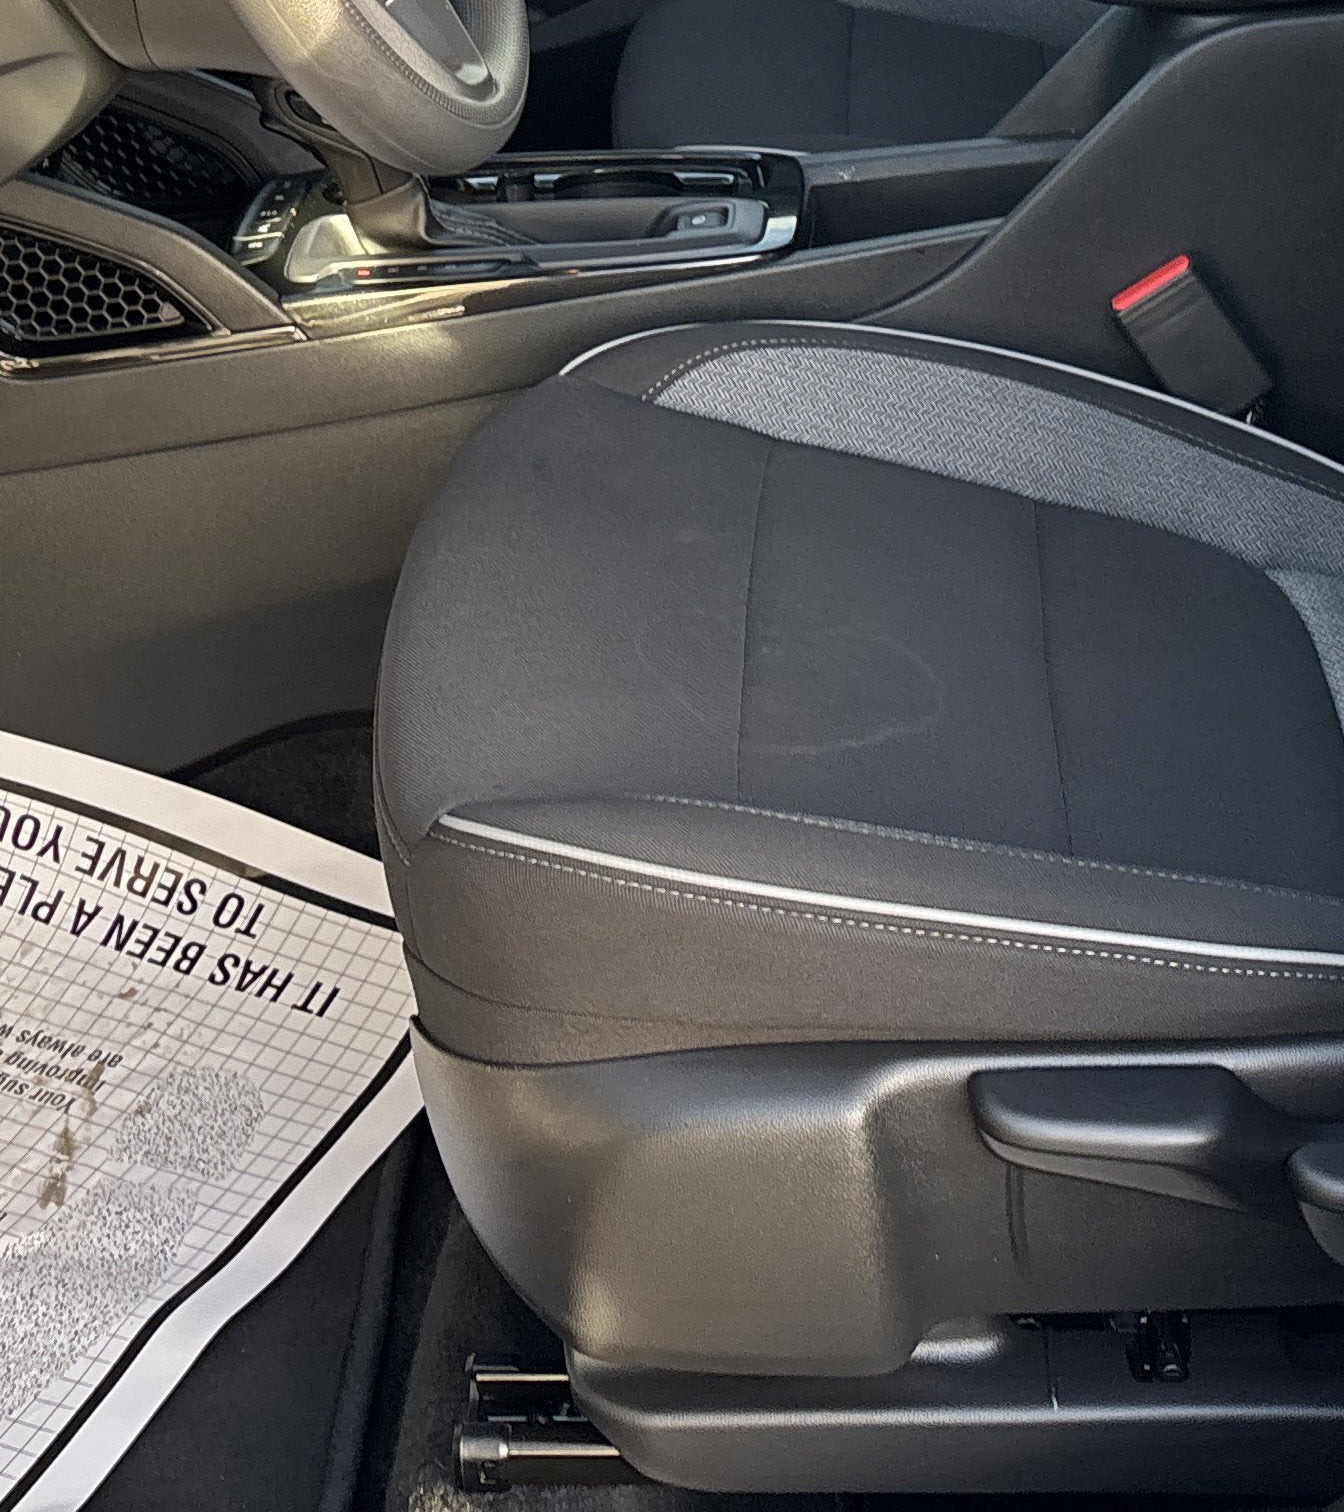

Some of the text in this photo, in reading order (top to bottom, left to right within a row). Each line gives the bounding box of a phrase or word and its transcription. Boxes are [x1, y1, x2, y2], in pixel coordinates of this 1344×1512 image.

[74, 834, 207, 916] SERVE
[69, 897, 104, 938] A
[211, 891, 265, 939] TO
[100, 913, 208, 976] BEEN
[208, 952, 295, 1003] HAS
[291, 981, 341, 1017] IT
[15, 1029, 86, 1059] always
[86, 1048, 124, 1068] are
[29, 1087, 75, 1115] Your
